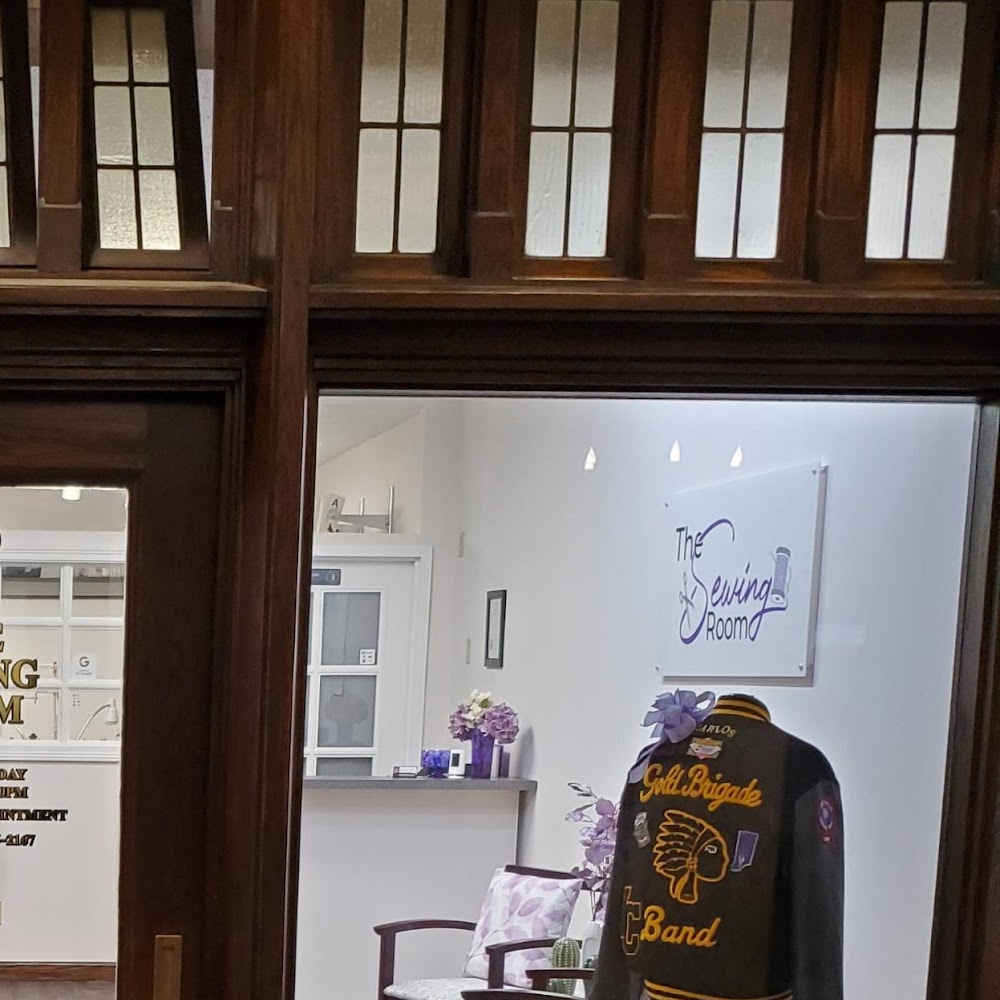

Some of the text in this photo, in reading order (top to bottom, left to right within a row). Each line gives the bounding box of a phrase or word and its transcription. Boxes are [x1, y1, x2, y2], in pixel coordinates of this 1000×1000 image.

[676, 526, 703, 562] The
[680, 519, 788, 645] Sewing
[706, 611, 748, 641] Room
[639, 763, 762, 812] Gold Brigade
[640, 905, 721, 947] Band
